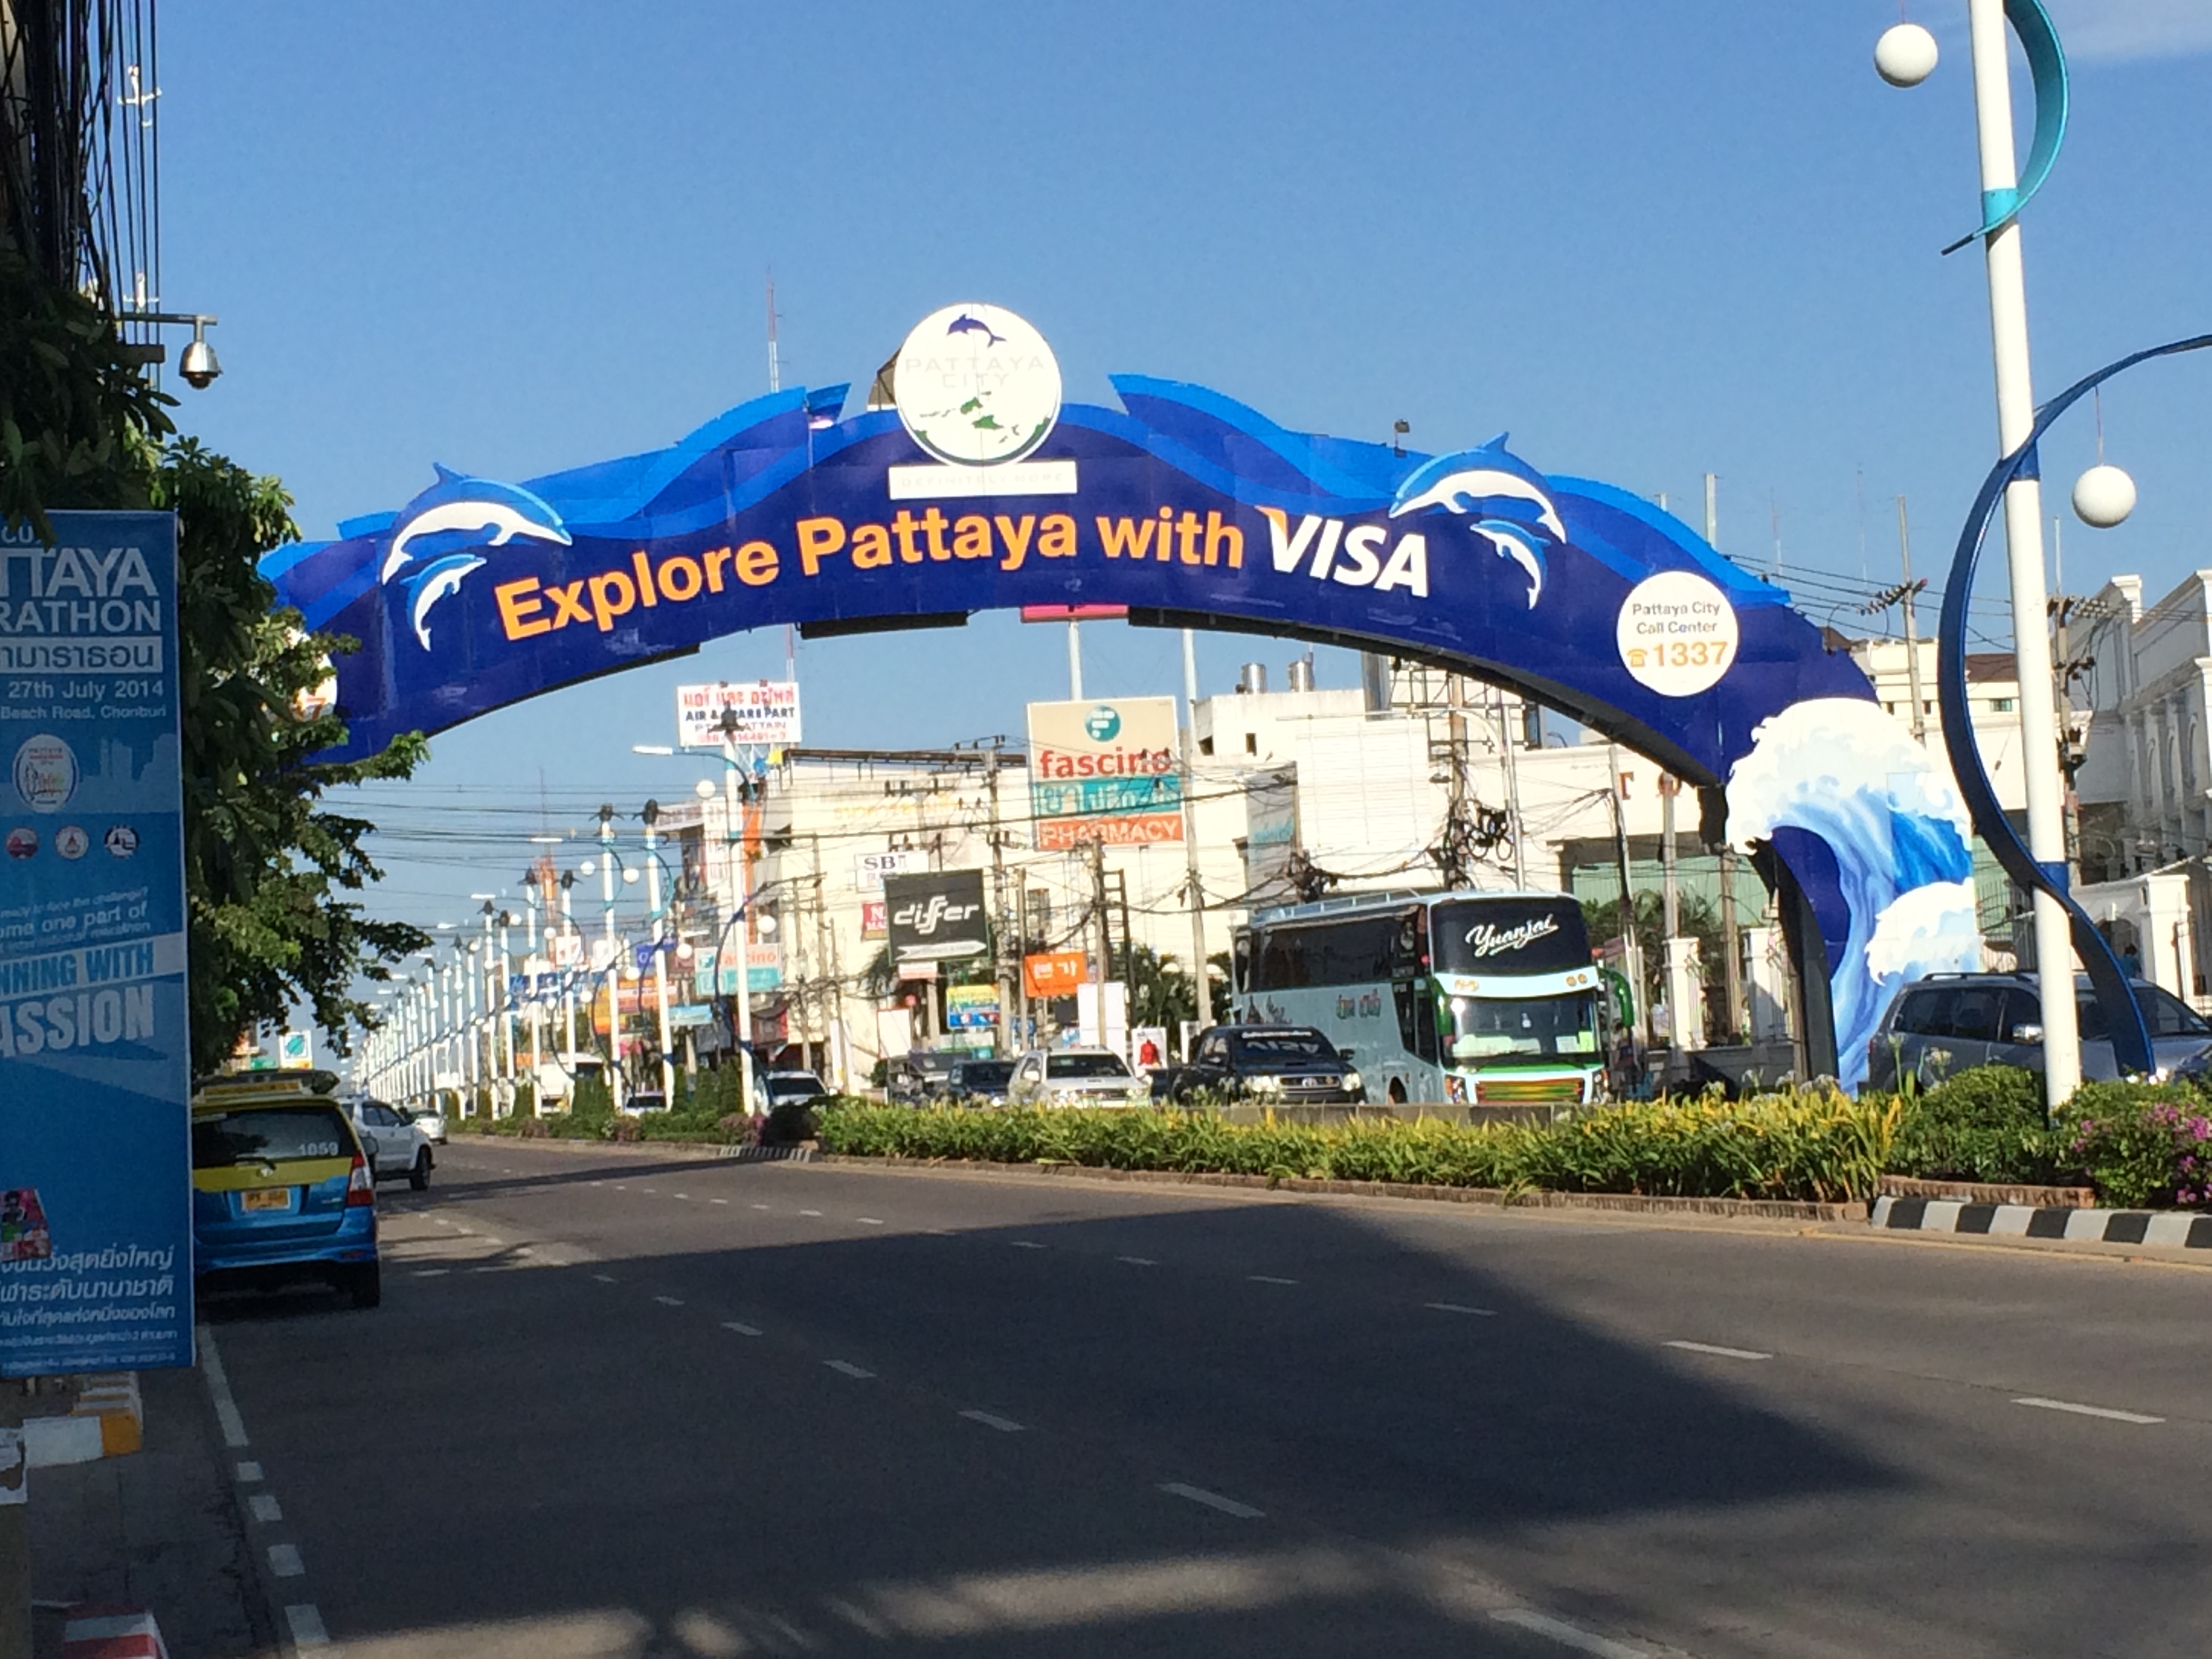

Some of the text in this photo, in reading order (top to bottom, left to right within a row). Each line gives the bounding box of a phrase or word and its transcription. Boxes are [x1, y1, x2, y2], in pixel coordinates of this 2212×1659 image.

[905, 356, 1044, 373] PATTAYA
[942, 373, 1010, 389] CITY
[494, 505, 1429, 641] Explore Pattaya with VISA
[1632, 601, 1721, 617] Pattaya City
[1636, 621, 1718, 634] Call Center
[1653, 641, 1729, 667] 1337
[8, 680, 164, 703] 27th July 2014
[686, 711, 707, 722] AIR
[1040, 746, 1172, 779] fascino
[1042, 818, 1179, 846] PHARMACY
[83, 906, 121, 930] part
[128, 900, 148, 919] of
[86, 941, 155, 983] WITH
